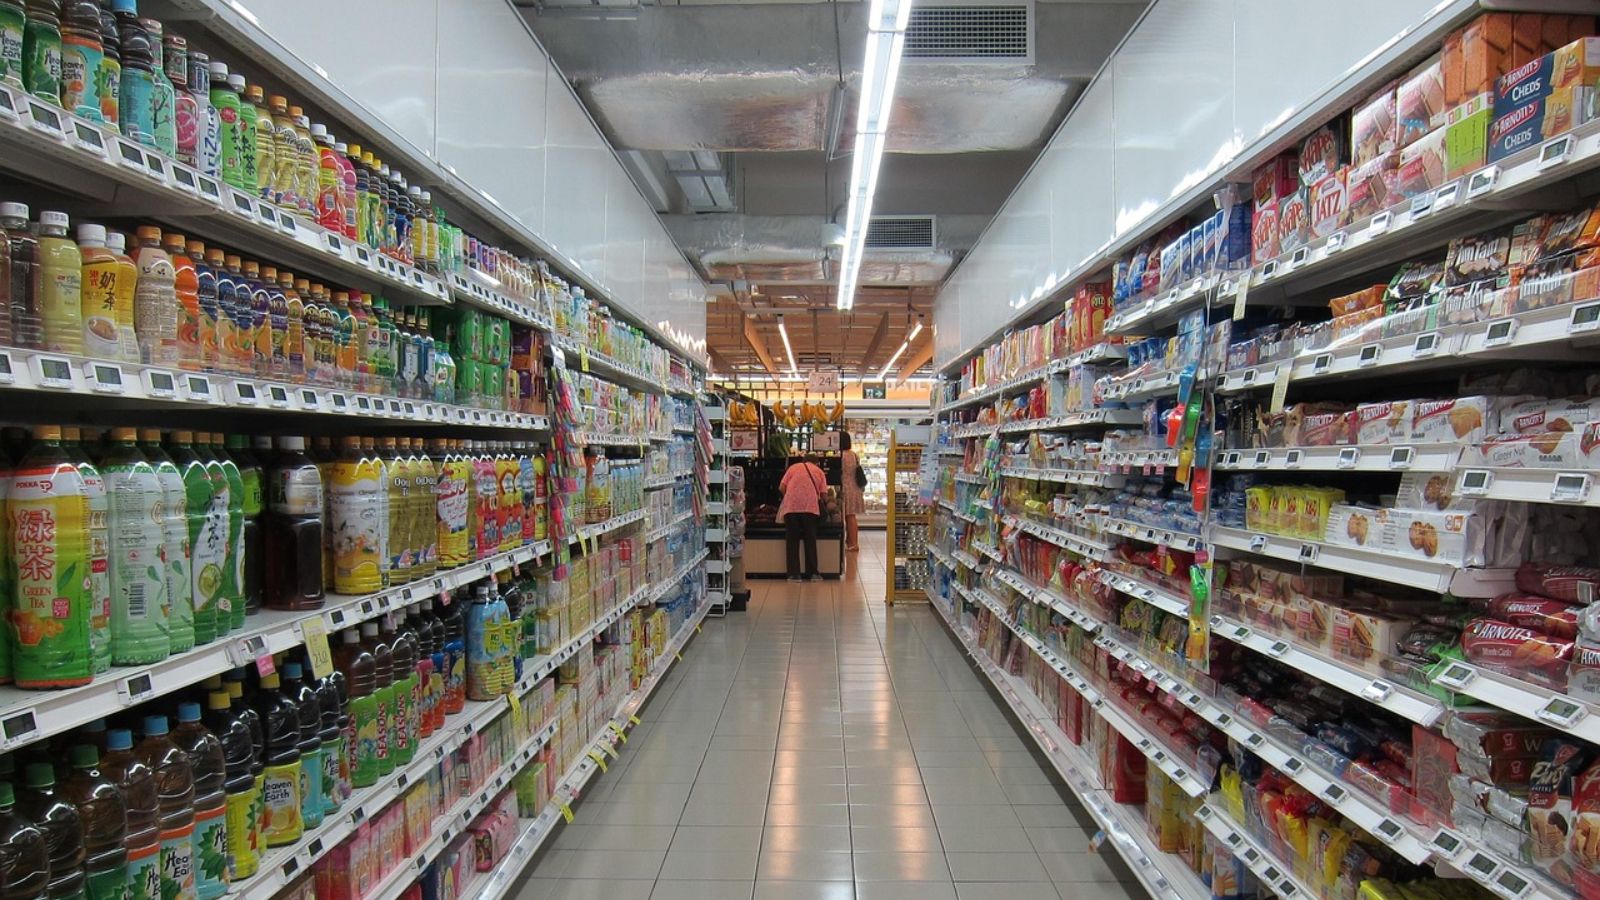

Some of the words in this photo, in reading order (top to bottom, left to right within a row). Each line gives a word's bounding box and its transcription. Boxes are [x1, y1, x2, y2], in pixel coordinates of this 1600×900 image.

[1511, 79, 1542, 102] CHEDS
[1504, 129, 1533, 150] CHEDS
[16, 481, 38, 489] POKKA
[23, 585, 52, 596] GREEN
[30, 597, 46, 609] TEA
[1478, 623, 1532, 641] ARNOTT'S
[397, 693, 407, 749] SEASONS
[377, 702, 387, 759] SEASONS
[264, 792, 290, 802] Earth
